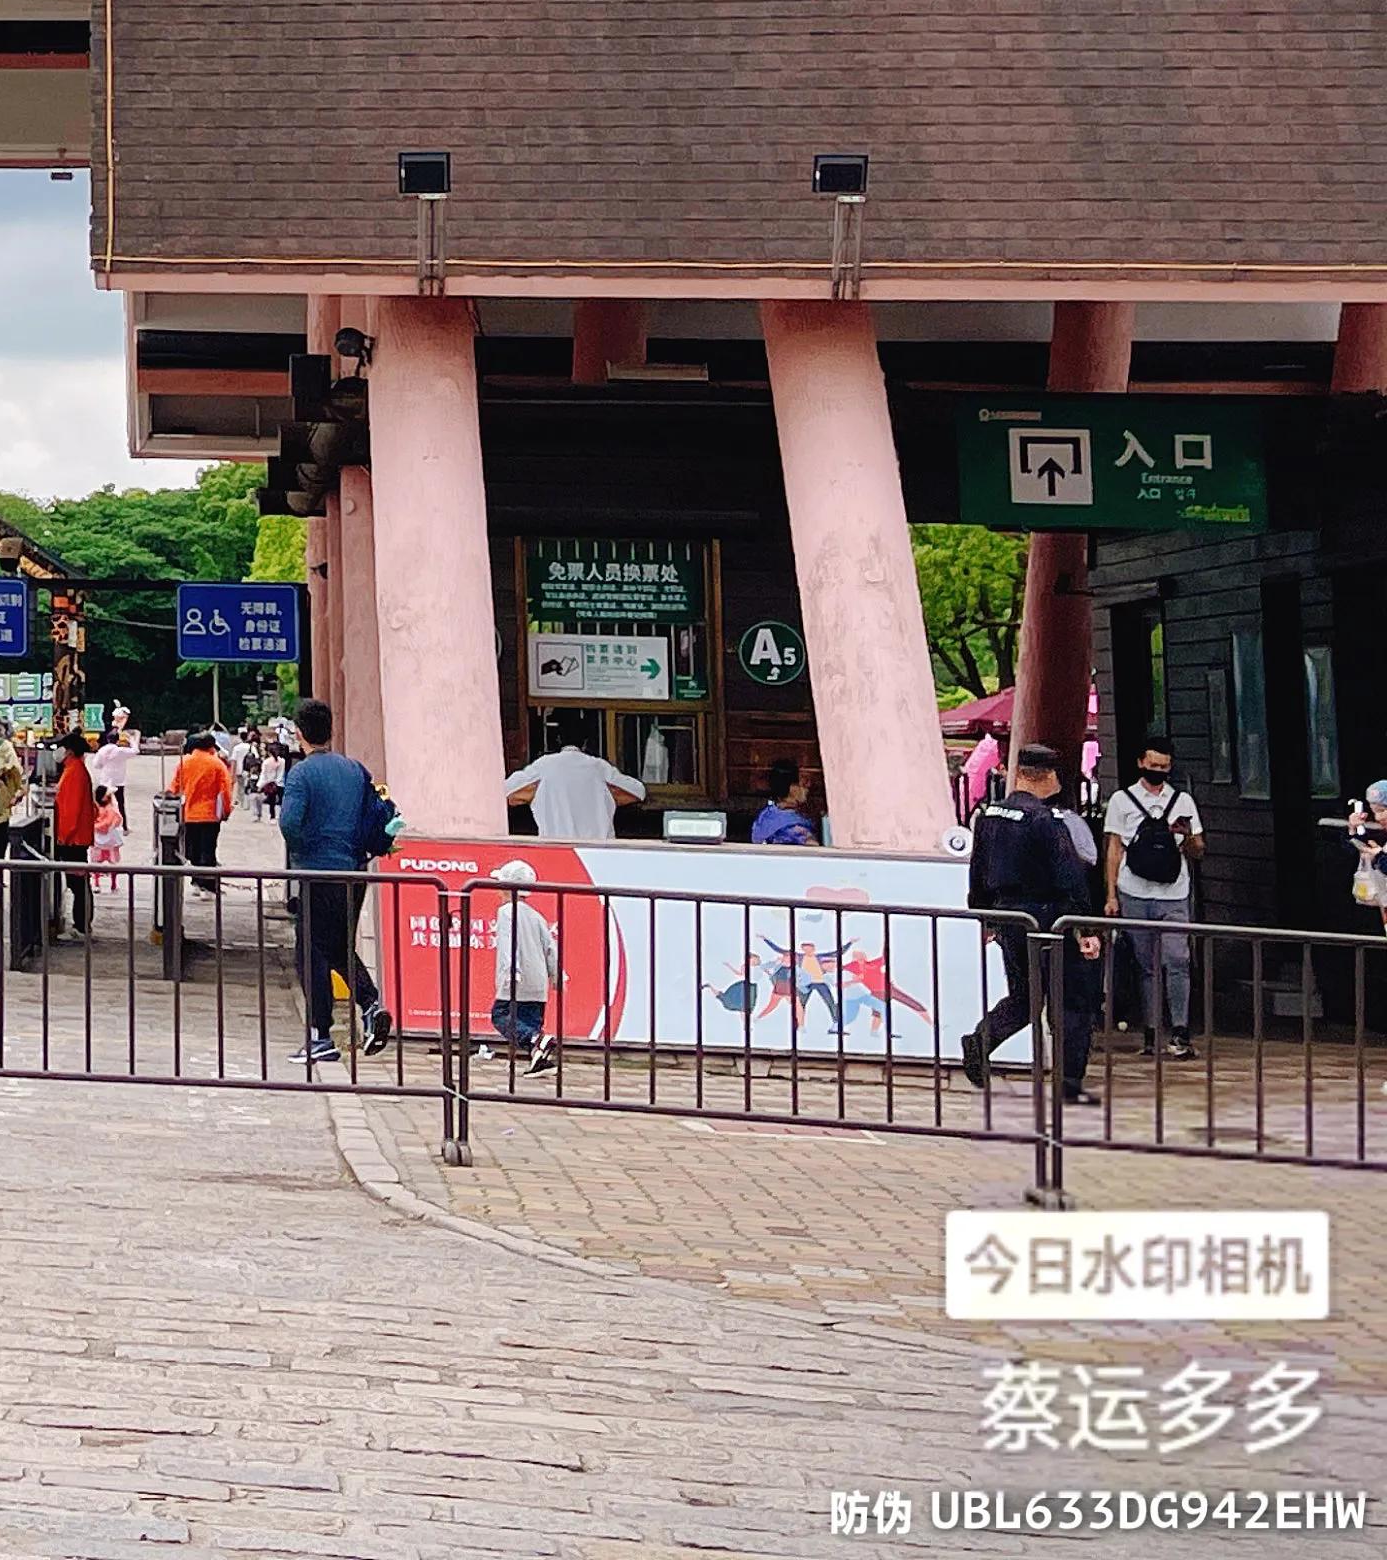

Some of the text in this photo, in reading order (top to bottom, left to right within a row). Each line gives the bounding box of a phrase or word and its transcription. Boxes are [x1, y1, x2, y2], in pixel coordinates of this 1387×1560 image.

[1114, 429, 1213, 470] 入口
[1141, 472, 1194, 484] Entrance
[548, 562, 679, 582] 免票人员换票处
[400, 858, 478, 873] PUDONG
